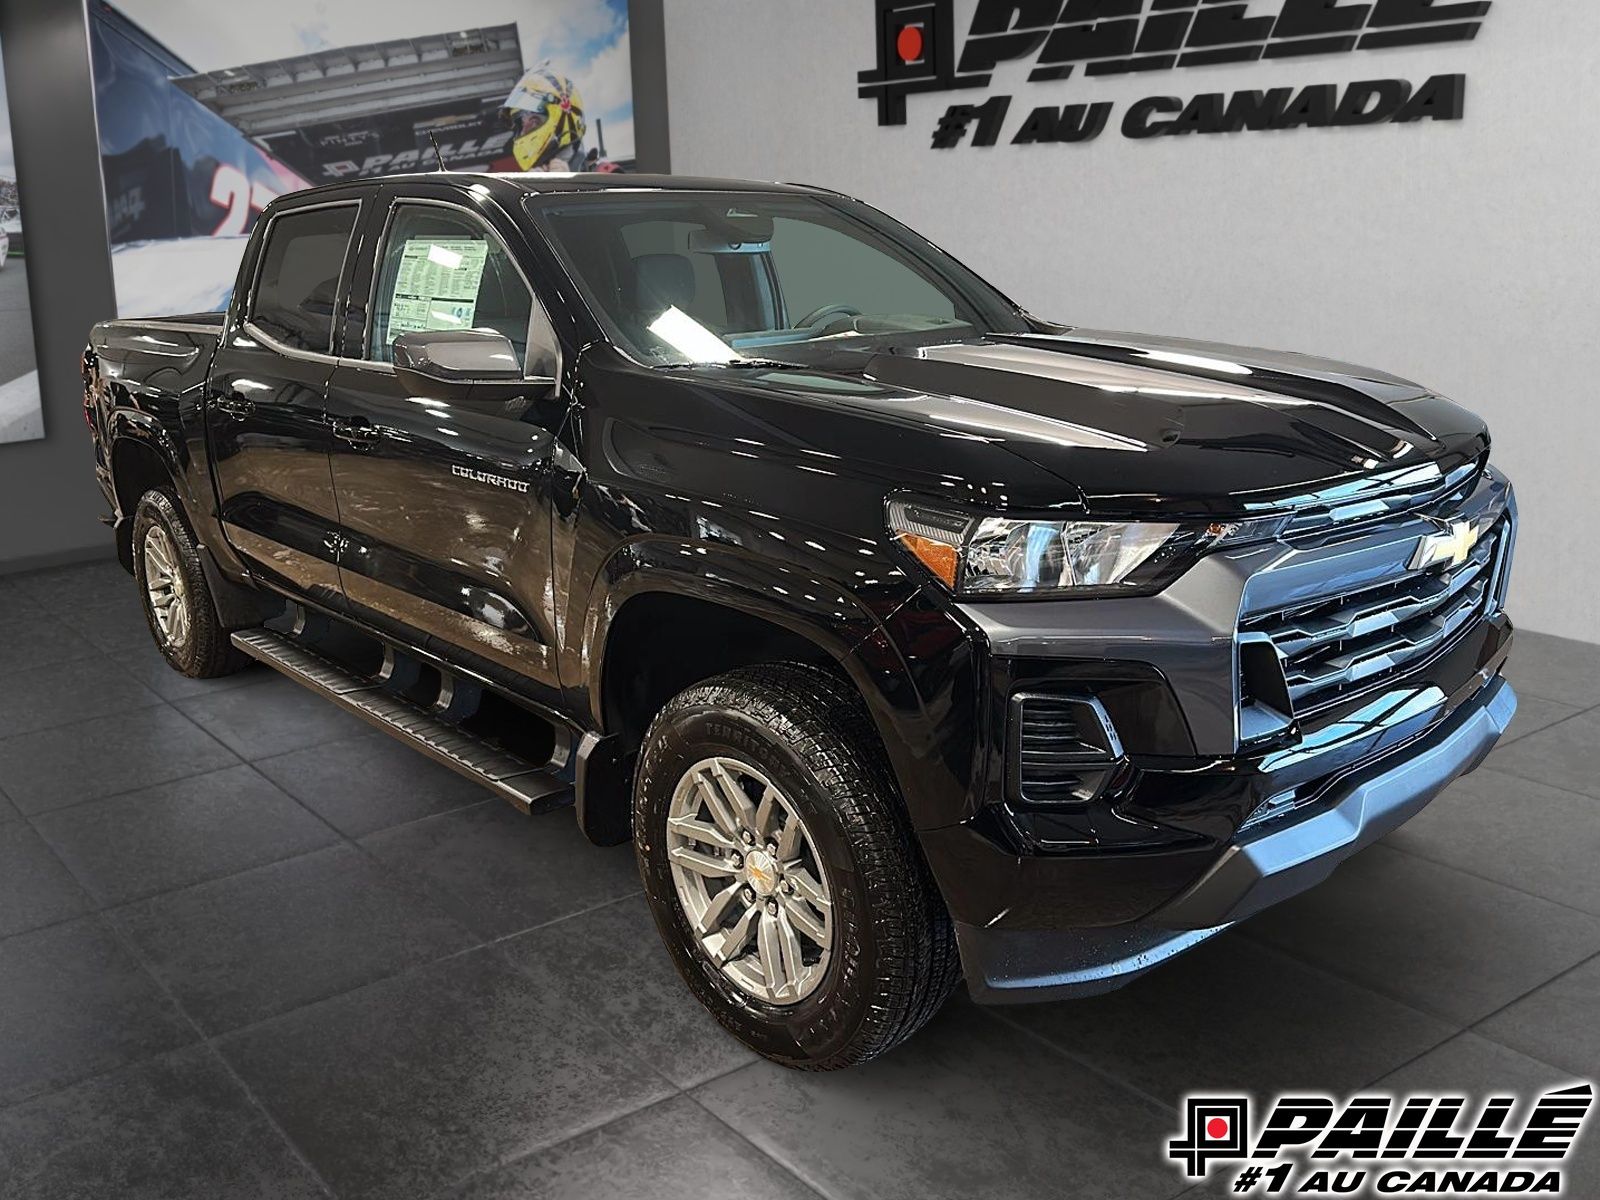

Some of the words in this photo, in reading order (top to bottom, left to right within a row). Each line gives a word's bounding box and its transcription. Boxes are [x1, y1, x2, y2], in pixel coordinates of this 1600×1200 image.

[930, 95, 1012, 149] #1
[1010, 102, 1114, 143] AU
[1121, 73, 1466, 140] CANADA
[451, 464, 530, 493] COLORADO
